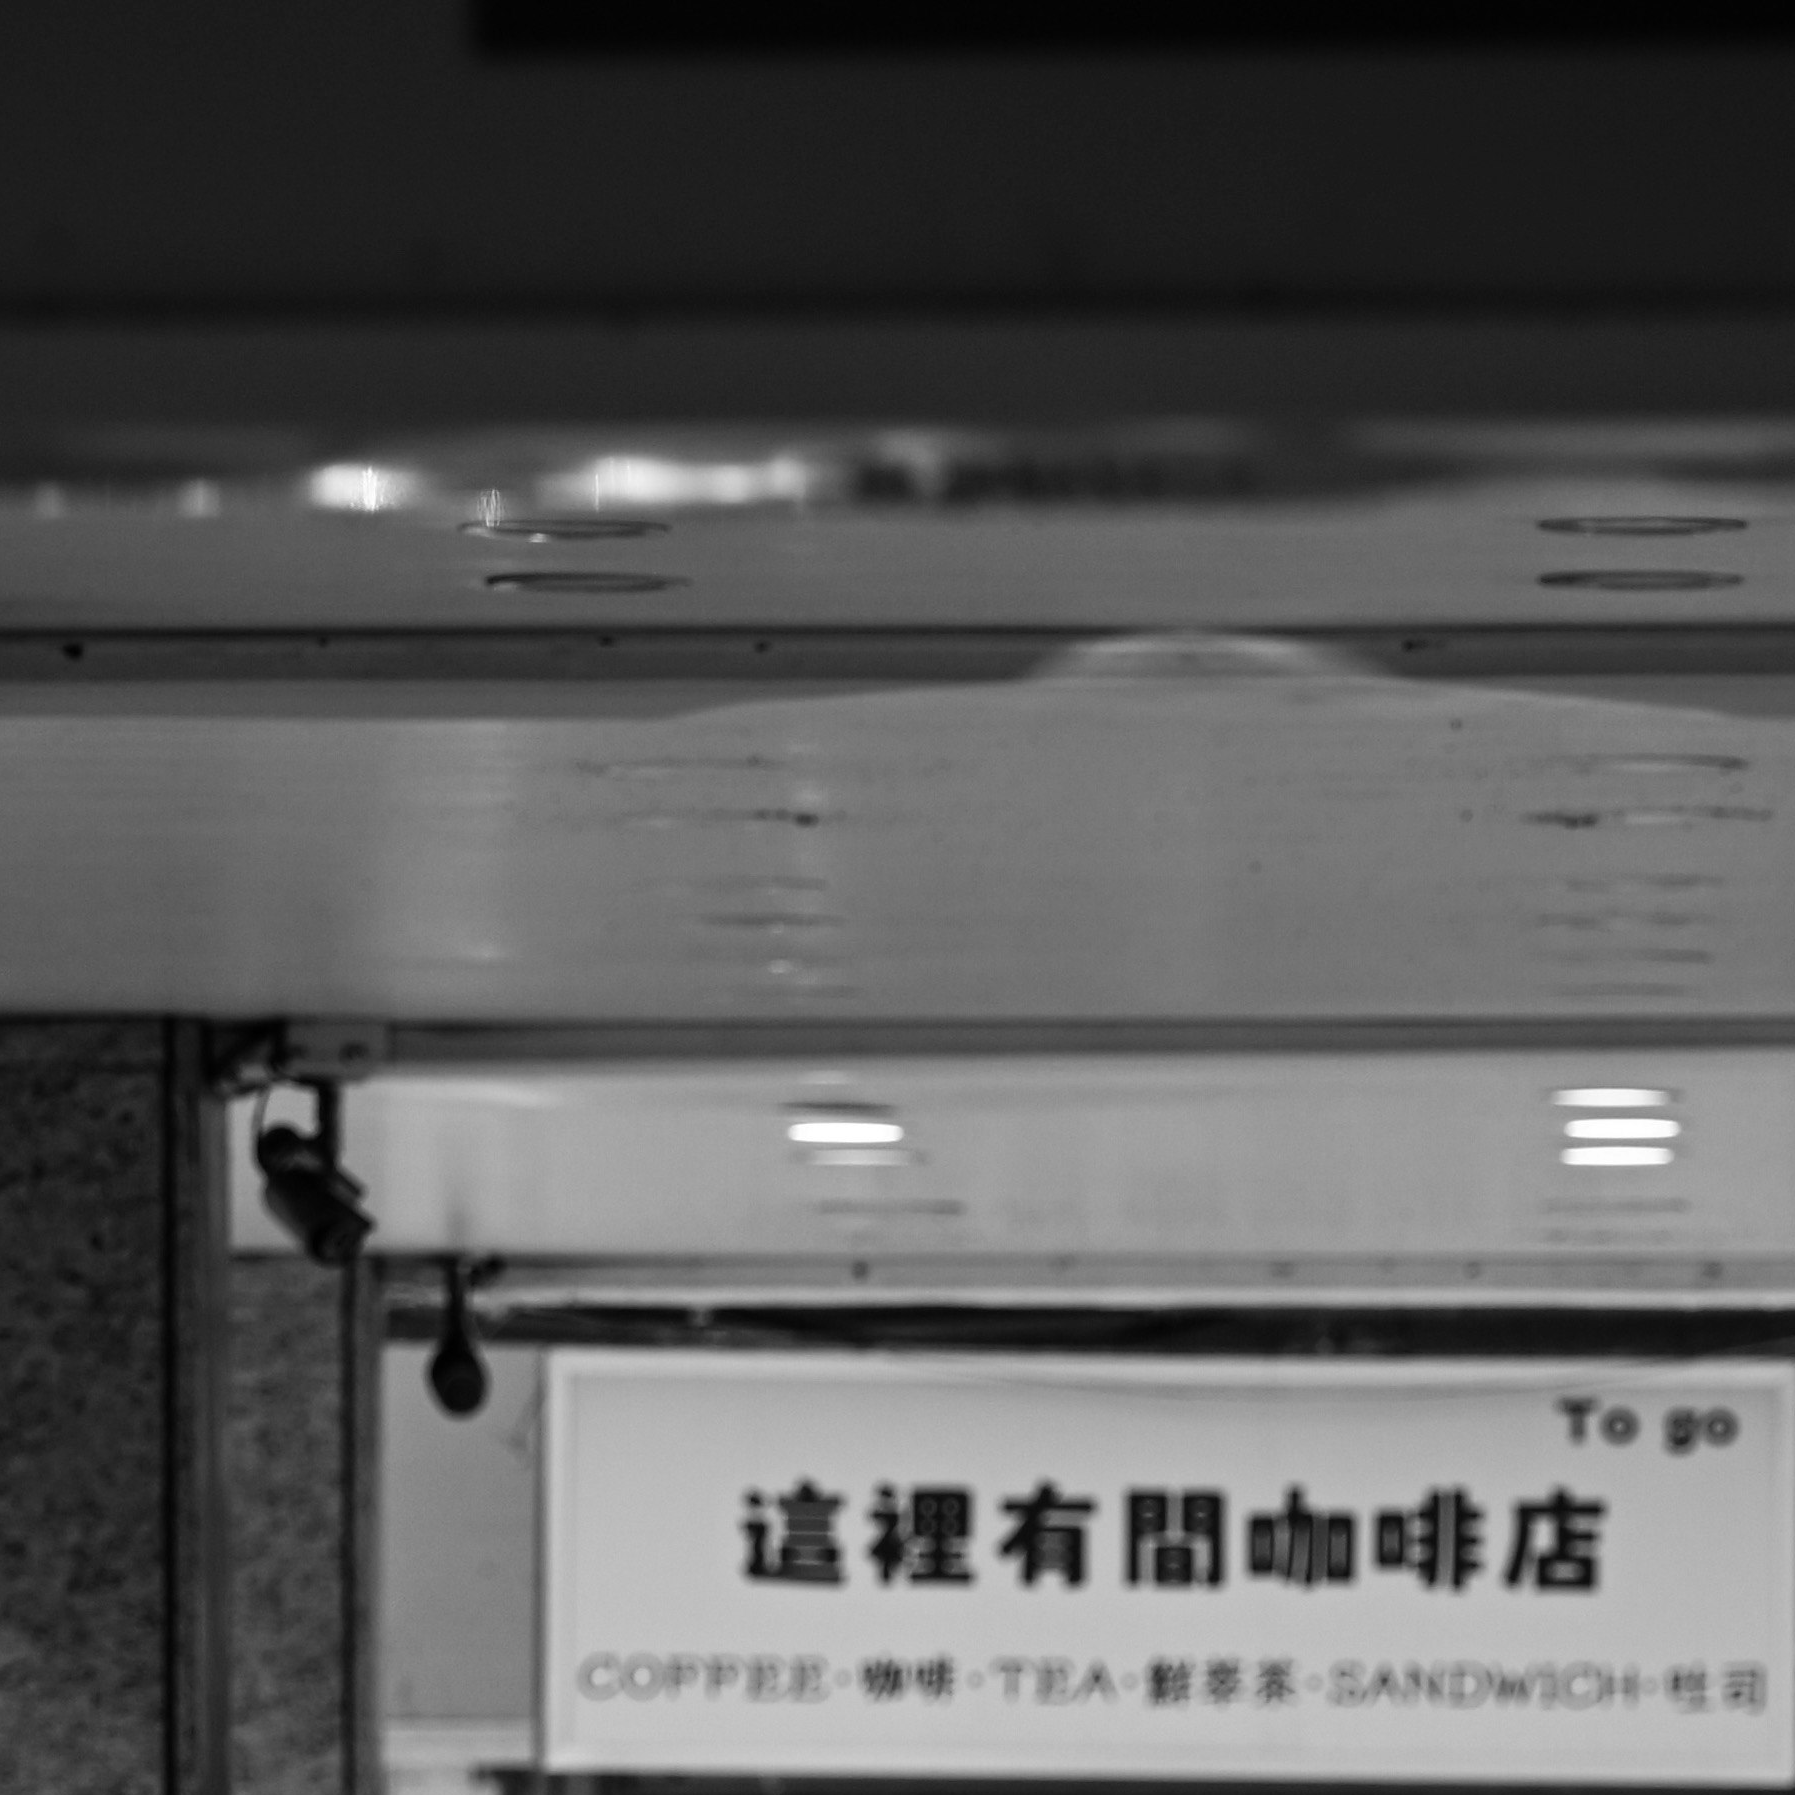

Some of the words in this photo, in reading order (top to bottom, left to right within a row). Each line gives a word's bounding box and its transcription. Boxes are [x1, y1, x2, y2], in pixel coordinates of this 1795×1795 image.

[1555, 1398, 1641, 1448] To
[1662, 1405, 1742, 1457] go
[741, 1477, 1608, 1591] 這裡有間咖啡店
